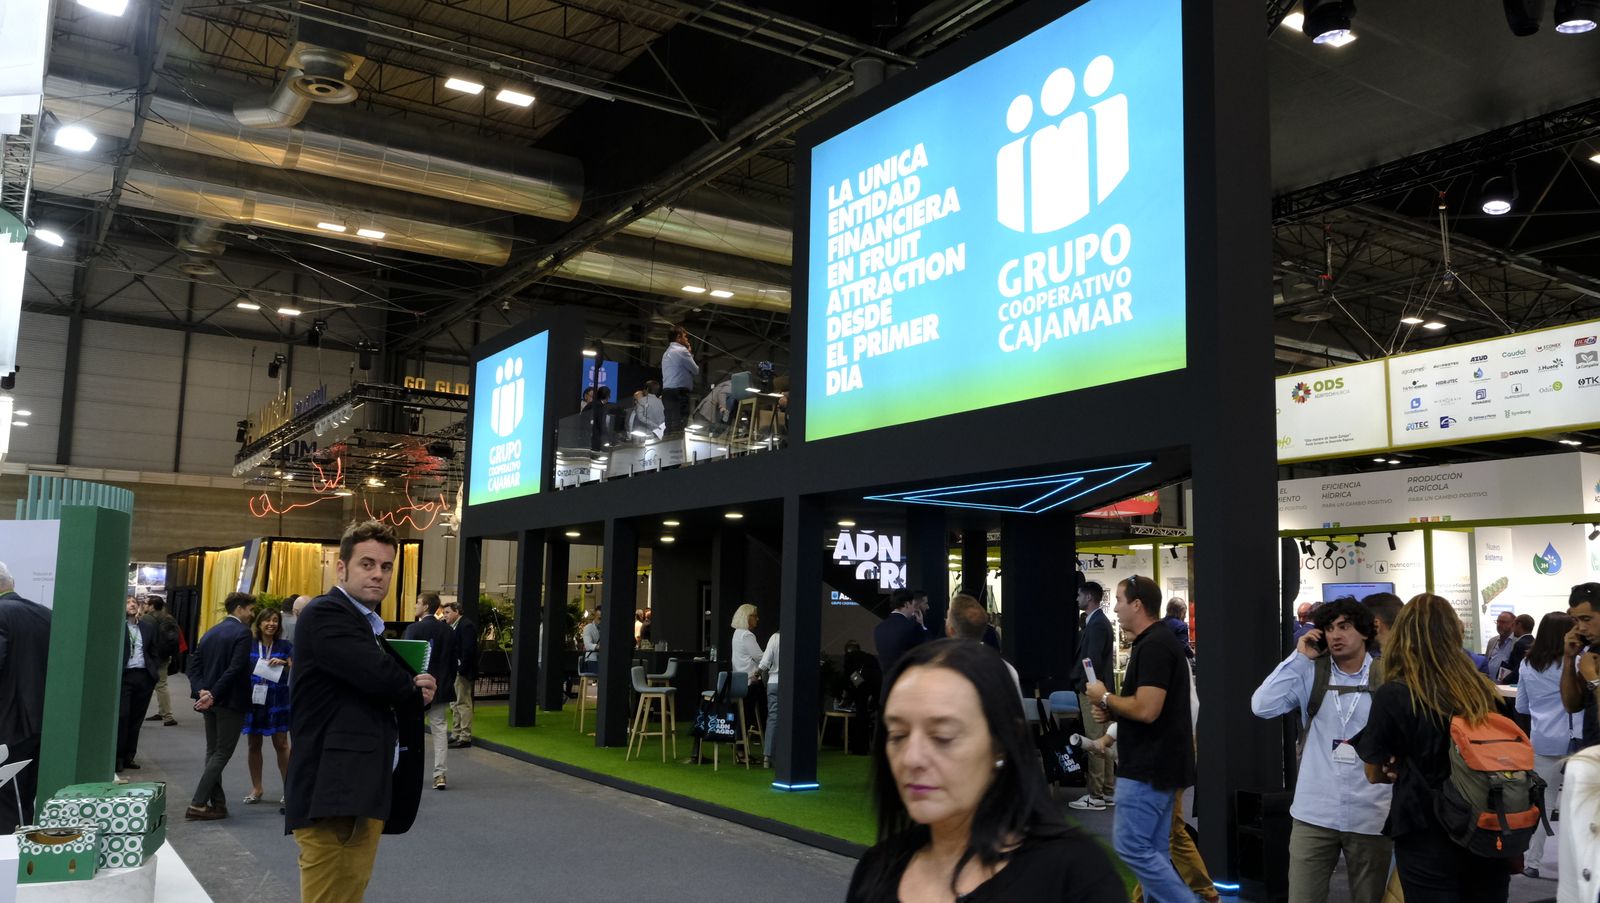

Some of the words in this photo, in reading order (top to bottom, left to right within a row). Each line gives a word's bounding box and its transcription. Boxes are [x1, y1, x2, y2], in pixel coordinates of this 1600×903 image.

[828, 178, 853, 211] LA
[858, 142, 928, 196] UNICA
[828, 175, 920, 238] ENTIDAD
[827, 186, 961, 265] FINANCIERA
[827, 256, 854, 289] EN
[860, 230, 921, 277] FRUIT
[997, 223, 1132, 298] GRUPO
[826, 242, 966, 317] ATTRACTION
[998, 266, 1132, 322] COOPERATIVO
[827, 297, 892, 341] DESDE
[998, 291, 1134, 352] CAJAMAR
[826, 340, 848, 369] EL
[853, 313, 940, 362] PRIMER
[1502, 348, 1527, 358] Caudal
[404, 376, 426, 390] GO
[826, 363, 864, 397] DIA
[1313, 378, 1345, 392] ODS
[489, 439, 521, 465] GRUPO
[488, 471, 520, 494] CAJAMAR
[489, 460, 520, 477] COOPERATIVO
[1407, 472, 1463, 483] PRODUCCIÓN
[1321, 481, 1361, 490] EFICIENCIA
[1321, 491, 1351, 500] HÍDRICA
[1407, 483, 1449, 493] AGRÍCOLA
[833, 532, 901, 562] ADN
